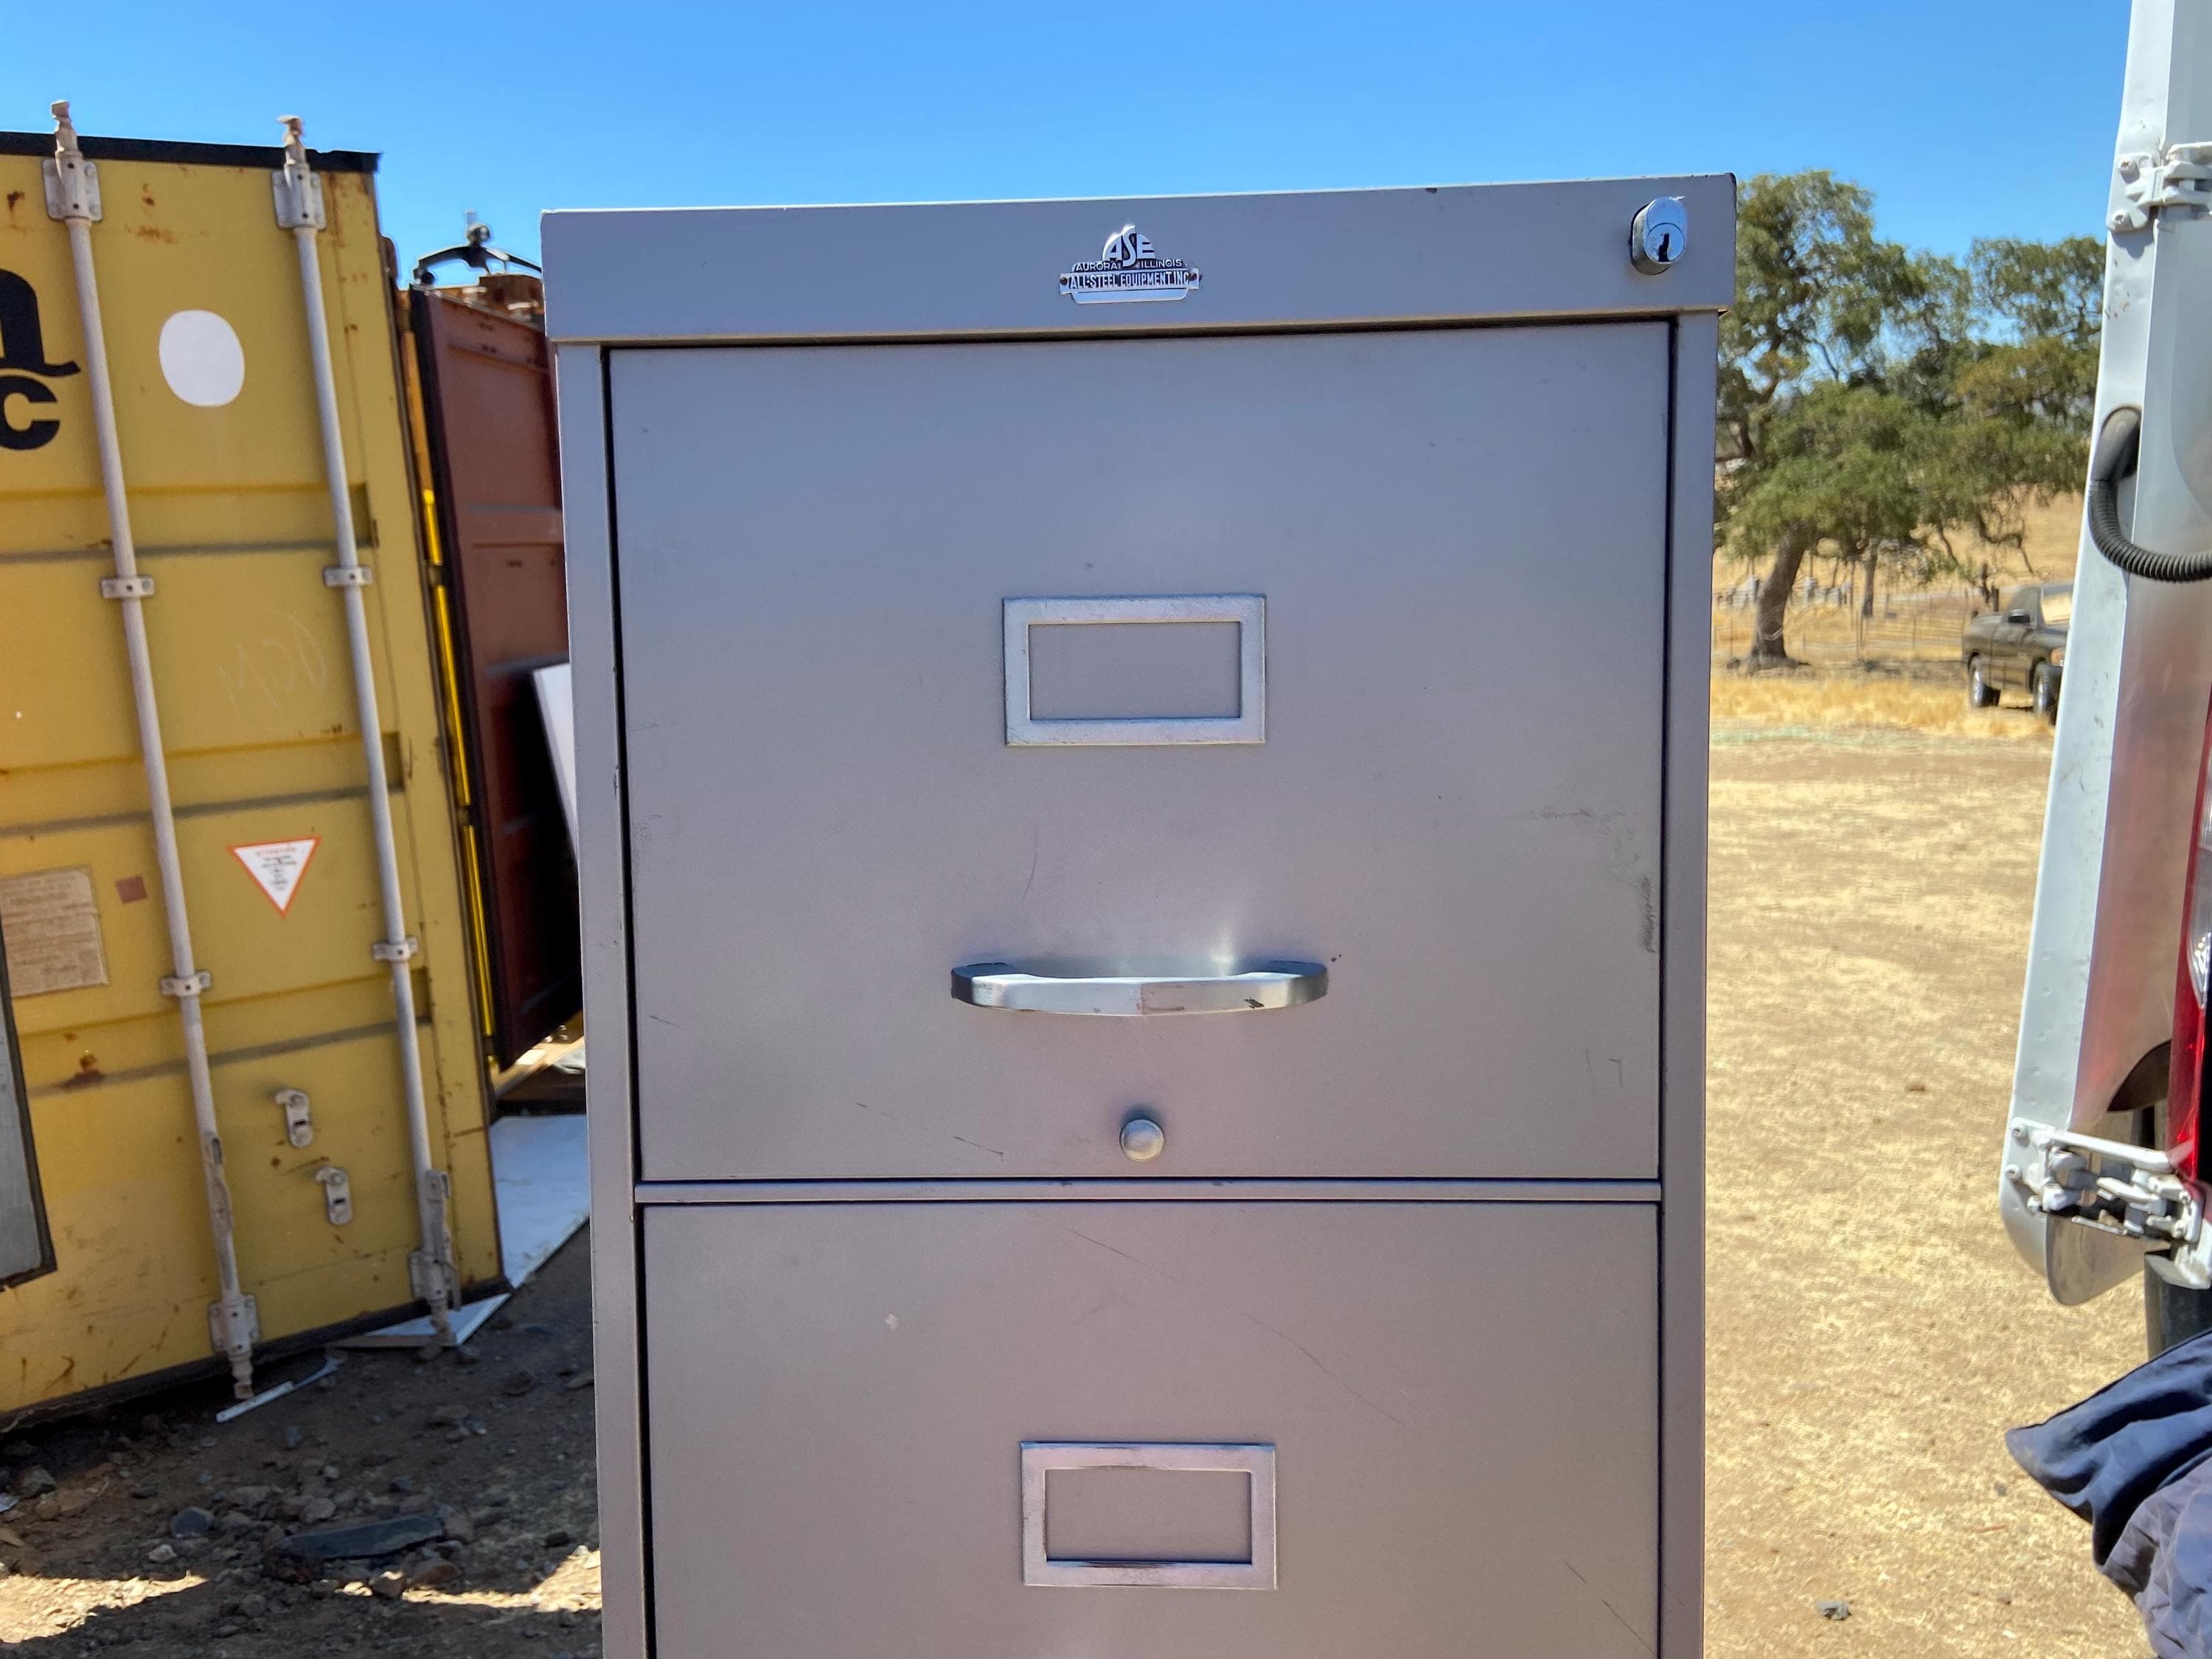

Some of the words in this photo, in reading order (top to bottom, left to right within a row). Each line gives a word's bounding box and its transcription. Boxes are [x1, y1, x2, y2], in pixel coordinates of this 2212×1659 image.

[1102, 225, 1156, 267] ASE
[1076, 260, 1119, 271] AURORA
[1141, 258, 1183, 268] ILLINOIS
[1120, 271, 1172, 287] EQUIPMENT
